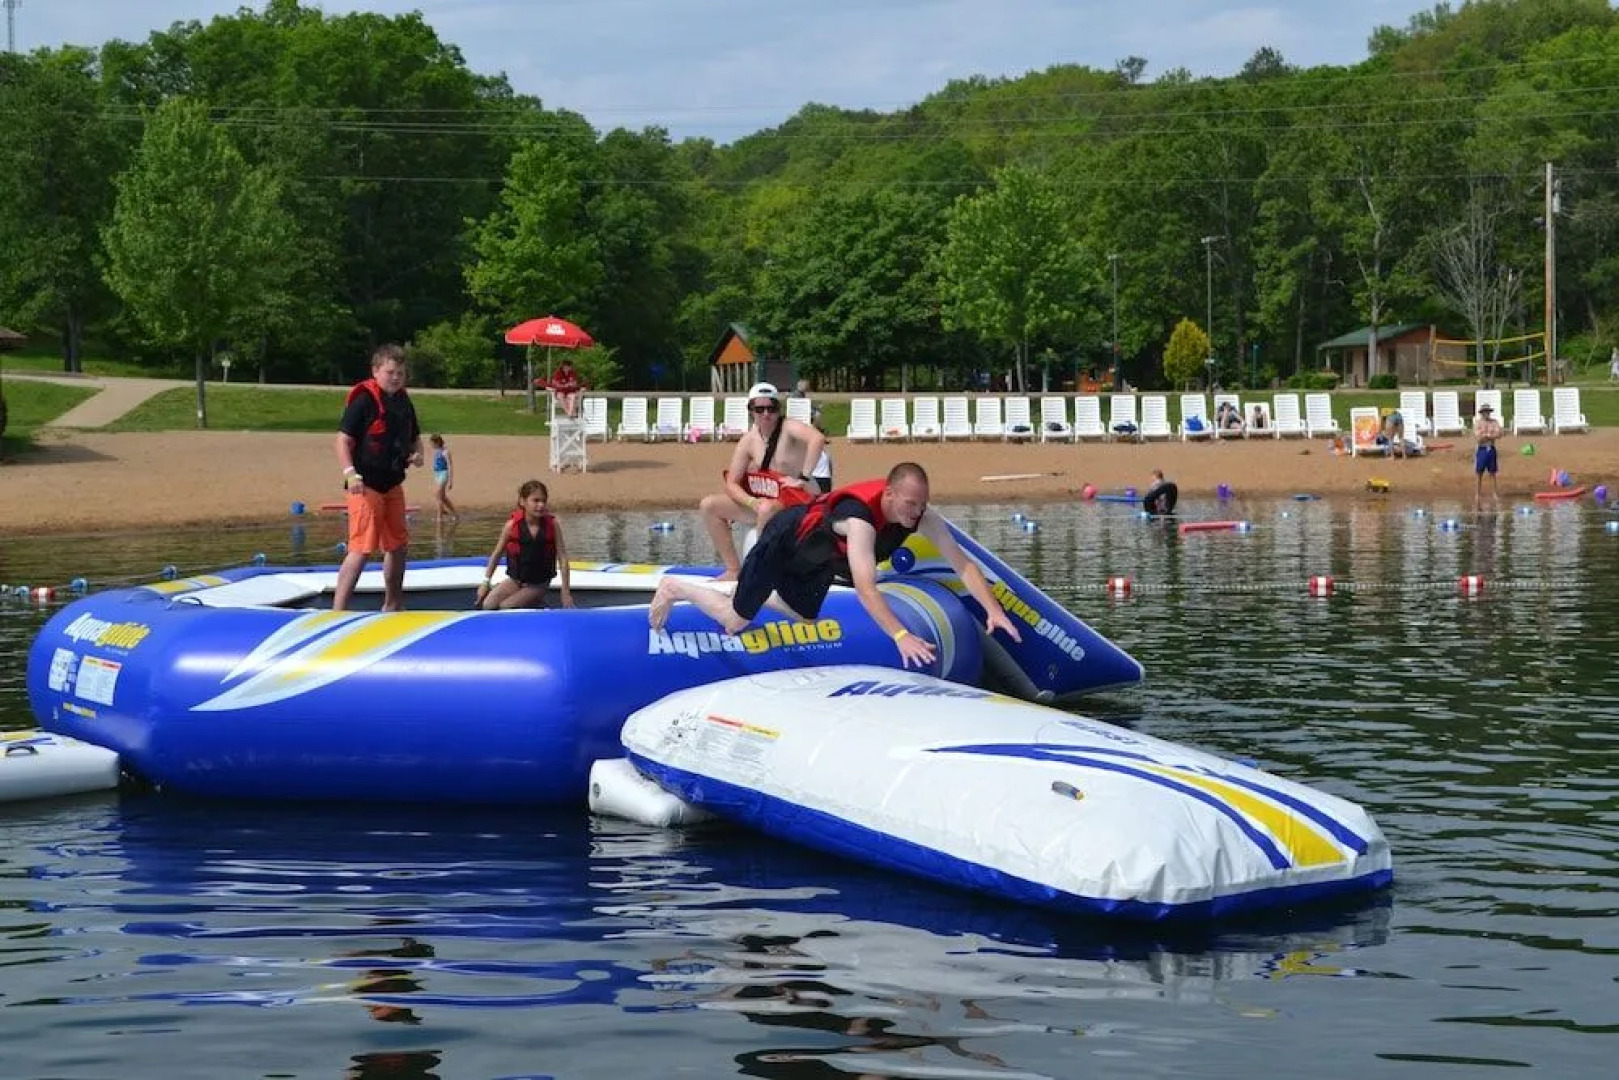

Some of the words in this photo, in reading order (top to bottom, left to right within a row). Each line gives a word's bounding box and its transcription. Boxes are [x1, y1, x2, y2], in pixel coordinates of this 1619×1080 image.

[748, 475, 779, 497] GUARD
[63, 612, 151, 648] Aquaglide
[989, 580, 1085, 661] Aquaglide
